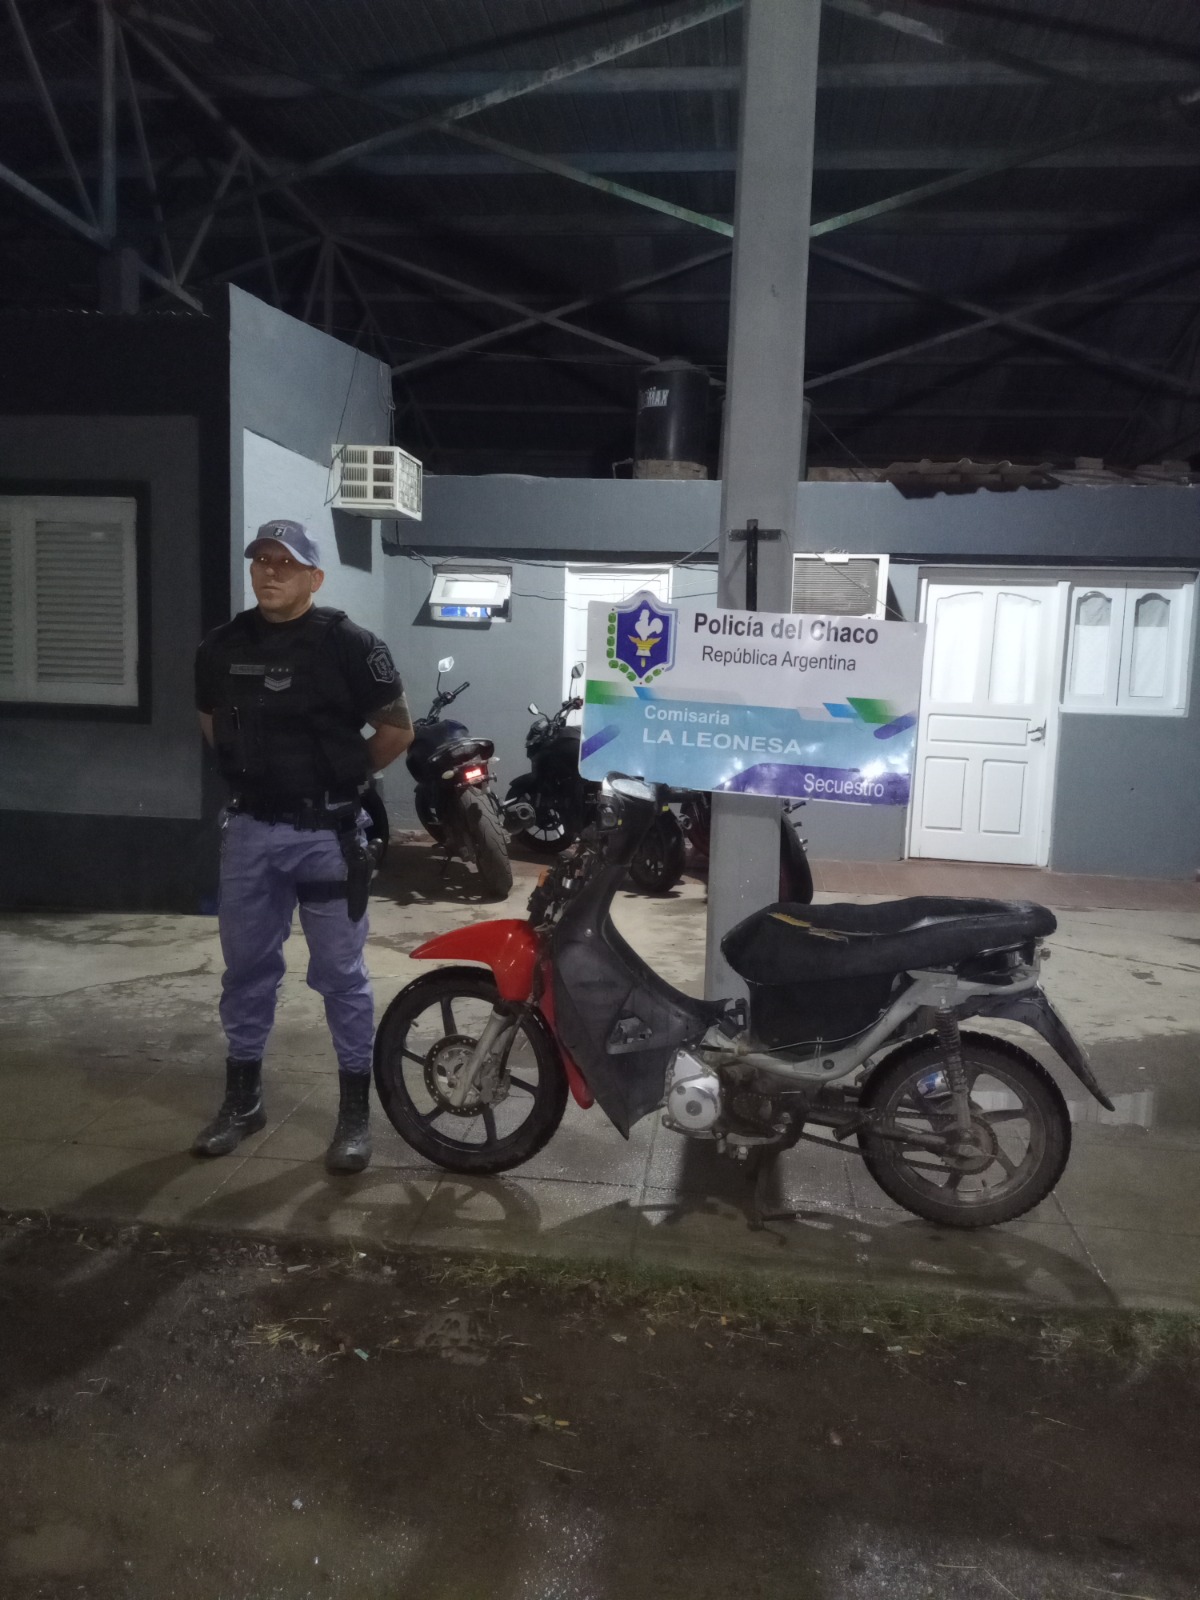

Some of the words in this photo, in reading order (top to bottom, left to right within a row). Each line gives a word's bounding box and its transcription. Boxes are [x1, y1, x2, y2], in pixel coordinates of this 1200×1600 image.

[694, 612, 764, 638] Policía
[771, 618, 802, 641] del
[810, 620, 879, 645] Chaco
[702, 646, 778, 667] República
[782, 651, 857, 672] Argentina
[644, 705, 730, 726] Comisaria
[642, 728, 675, 745] LA
[682, 731, 803, 756] LEONESA
[803, 774, 885, 799] Secuestro
